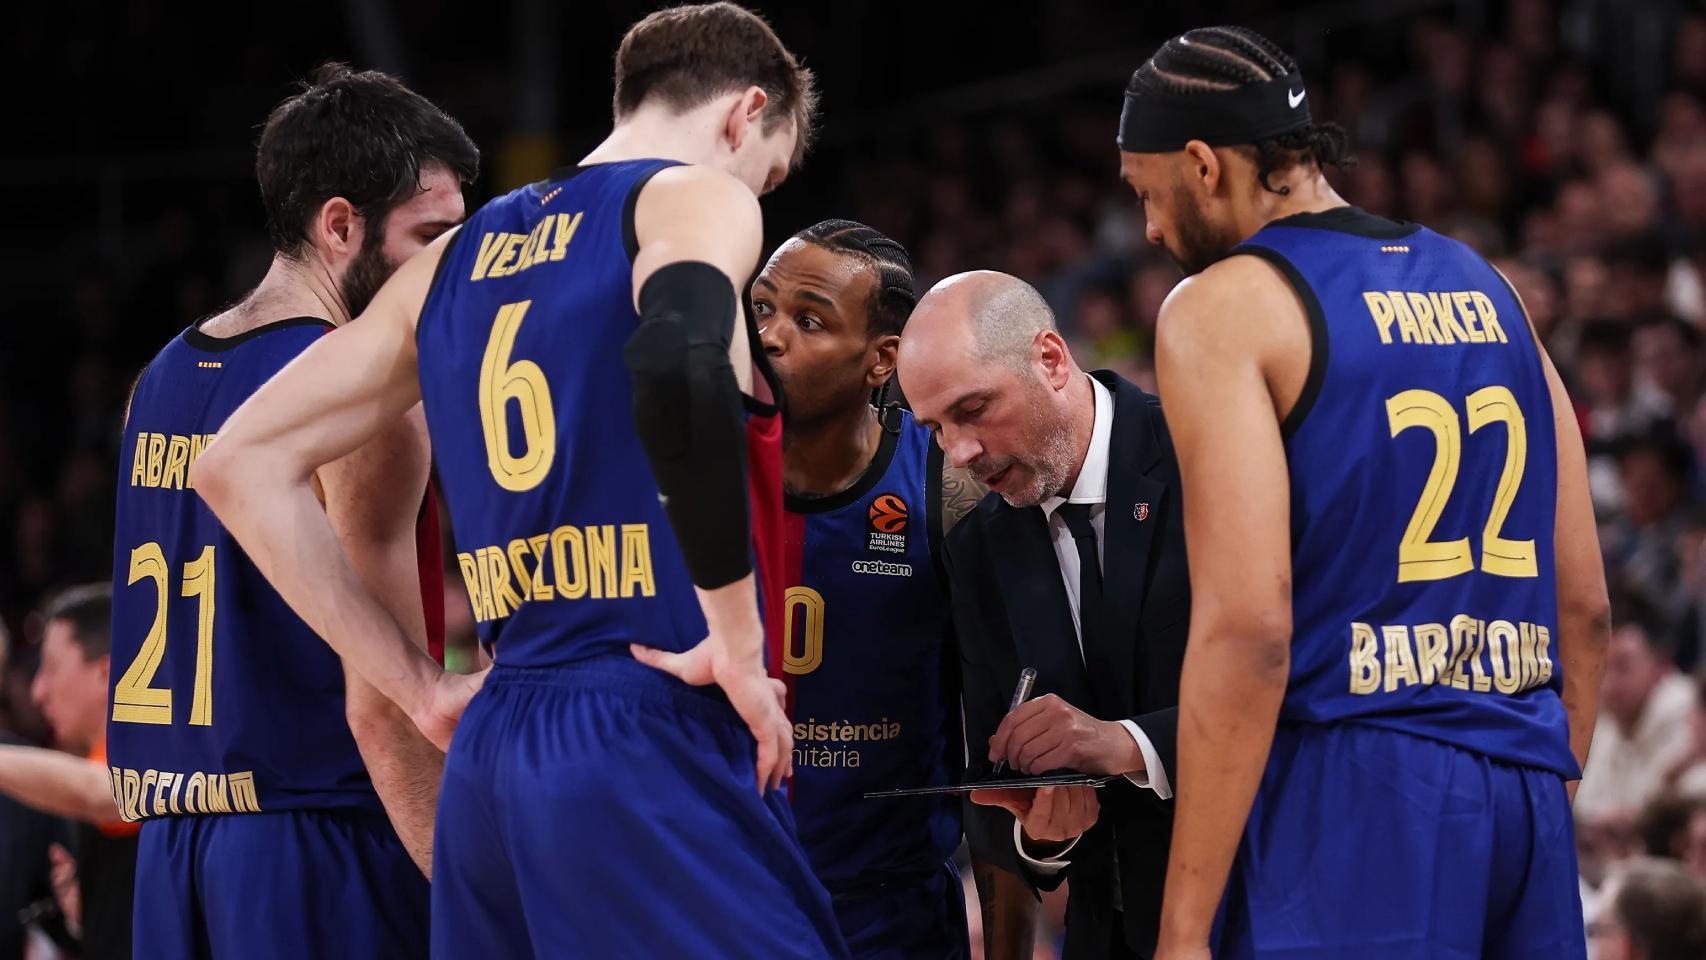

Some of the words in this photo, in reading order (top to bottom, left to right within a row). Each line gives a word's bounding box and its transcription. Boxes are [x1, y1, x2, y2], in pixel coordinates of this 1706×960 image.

[1363, 291, 1508, 345] PARKER
[478, 299, 556, 492] 6
[1385, 385, 1539, 583] 22
[869, 539, 905, 548] AIRLINES
[870, 532, 905, 541] TURKISH
[852, 560, 912, 576] oneteam
[112, 541, 216, 726] 21
[782, 586, 825, 675] 0
[107, 767, 262, 823] ARCELONA
